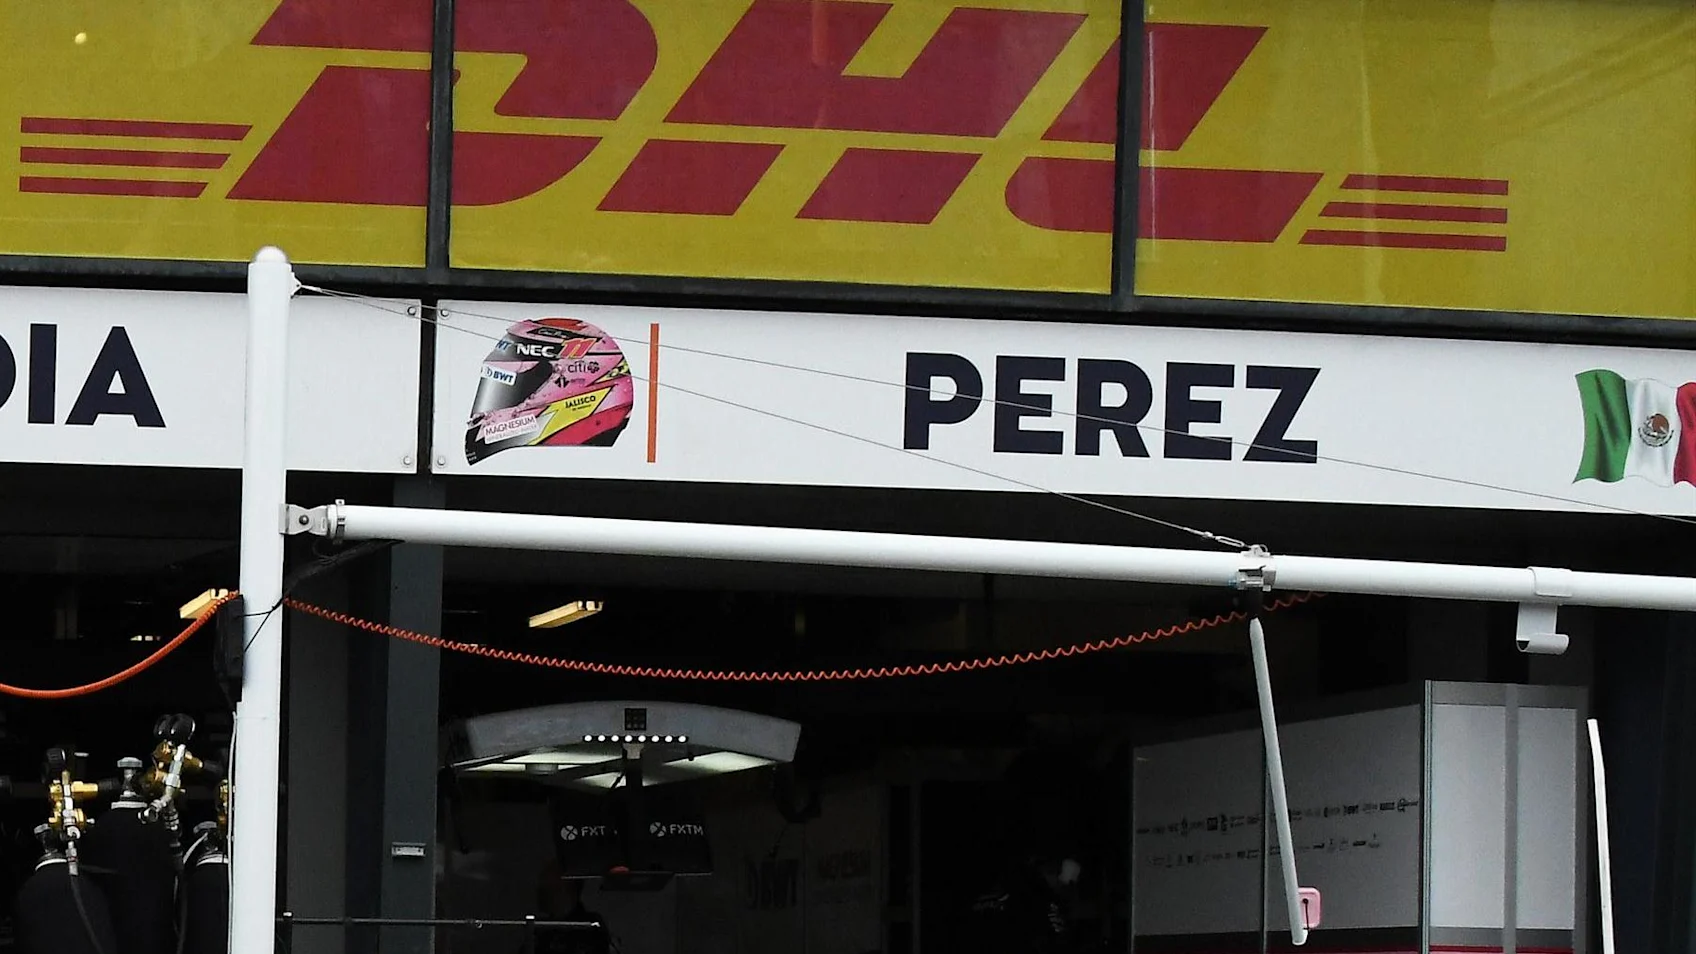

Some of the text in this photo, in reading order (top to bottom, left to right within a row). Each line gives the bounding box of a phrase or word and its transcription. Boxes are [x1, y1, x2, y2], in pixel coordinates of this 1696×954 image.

[225, 0, 1323, 243] DHL
[516, 343, 555, 358] NEC
[492, 370, 515, 384] BWT
[564, 394, 596, 409] JALISCO
[904, 351, 1322, 464] PEREZ
[485, 416, 536, 436] MAGNESIUM
[669, 823, 704, 836] FXTM
